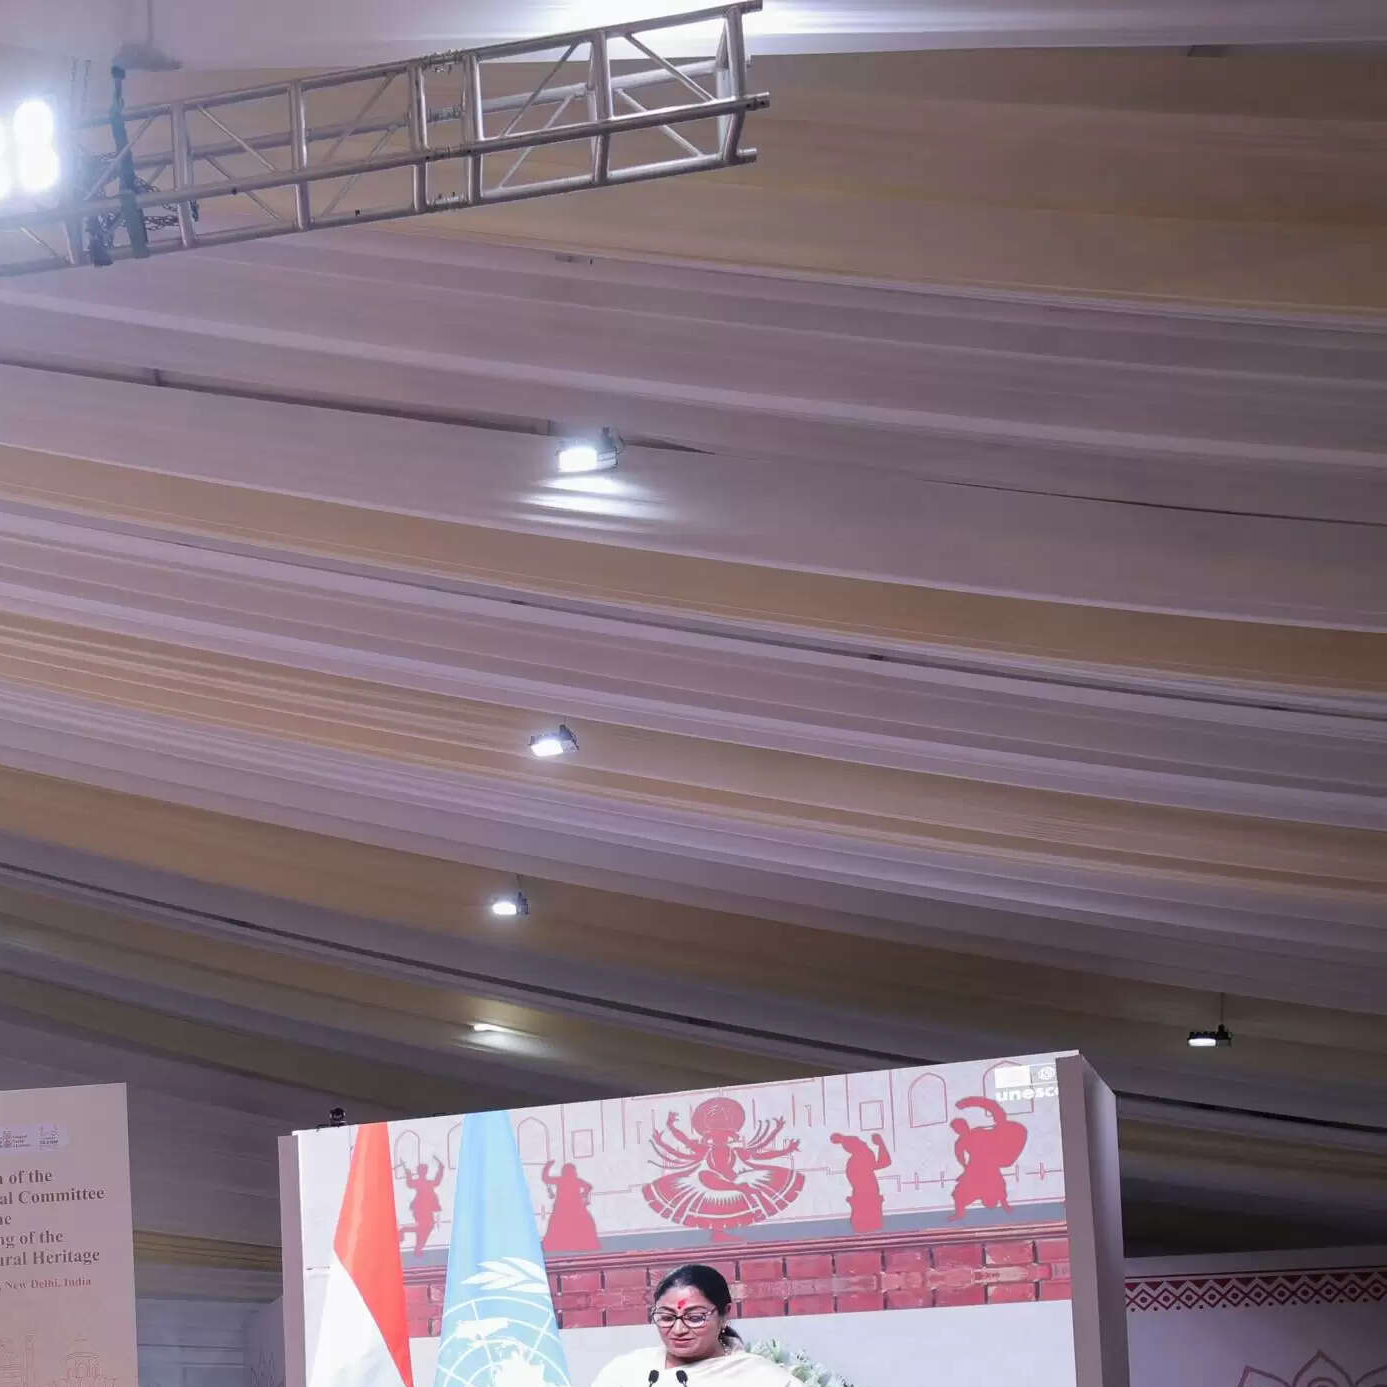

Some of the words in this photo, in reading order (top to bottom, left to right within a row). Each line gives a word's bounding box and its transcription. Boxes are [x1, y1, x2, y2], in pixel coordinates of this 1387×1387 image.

[995, 1087, 1059, 1101] unesc
[9, 1170, 25, 1185] of
[28, 1169, 52, 1183] the
[18, 1187, 105, 1205] Committee
[19, 1231, 36, 1246] of
[39, 1229, 64, 1244] the
[32, 1248, 100, 1267] Heritage
[5, 1279, 26, 1290] New
[64, 1276, 91, 1288] India
